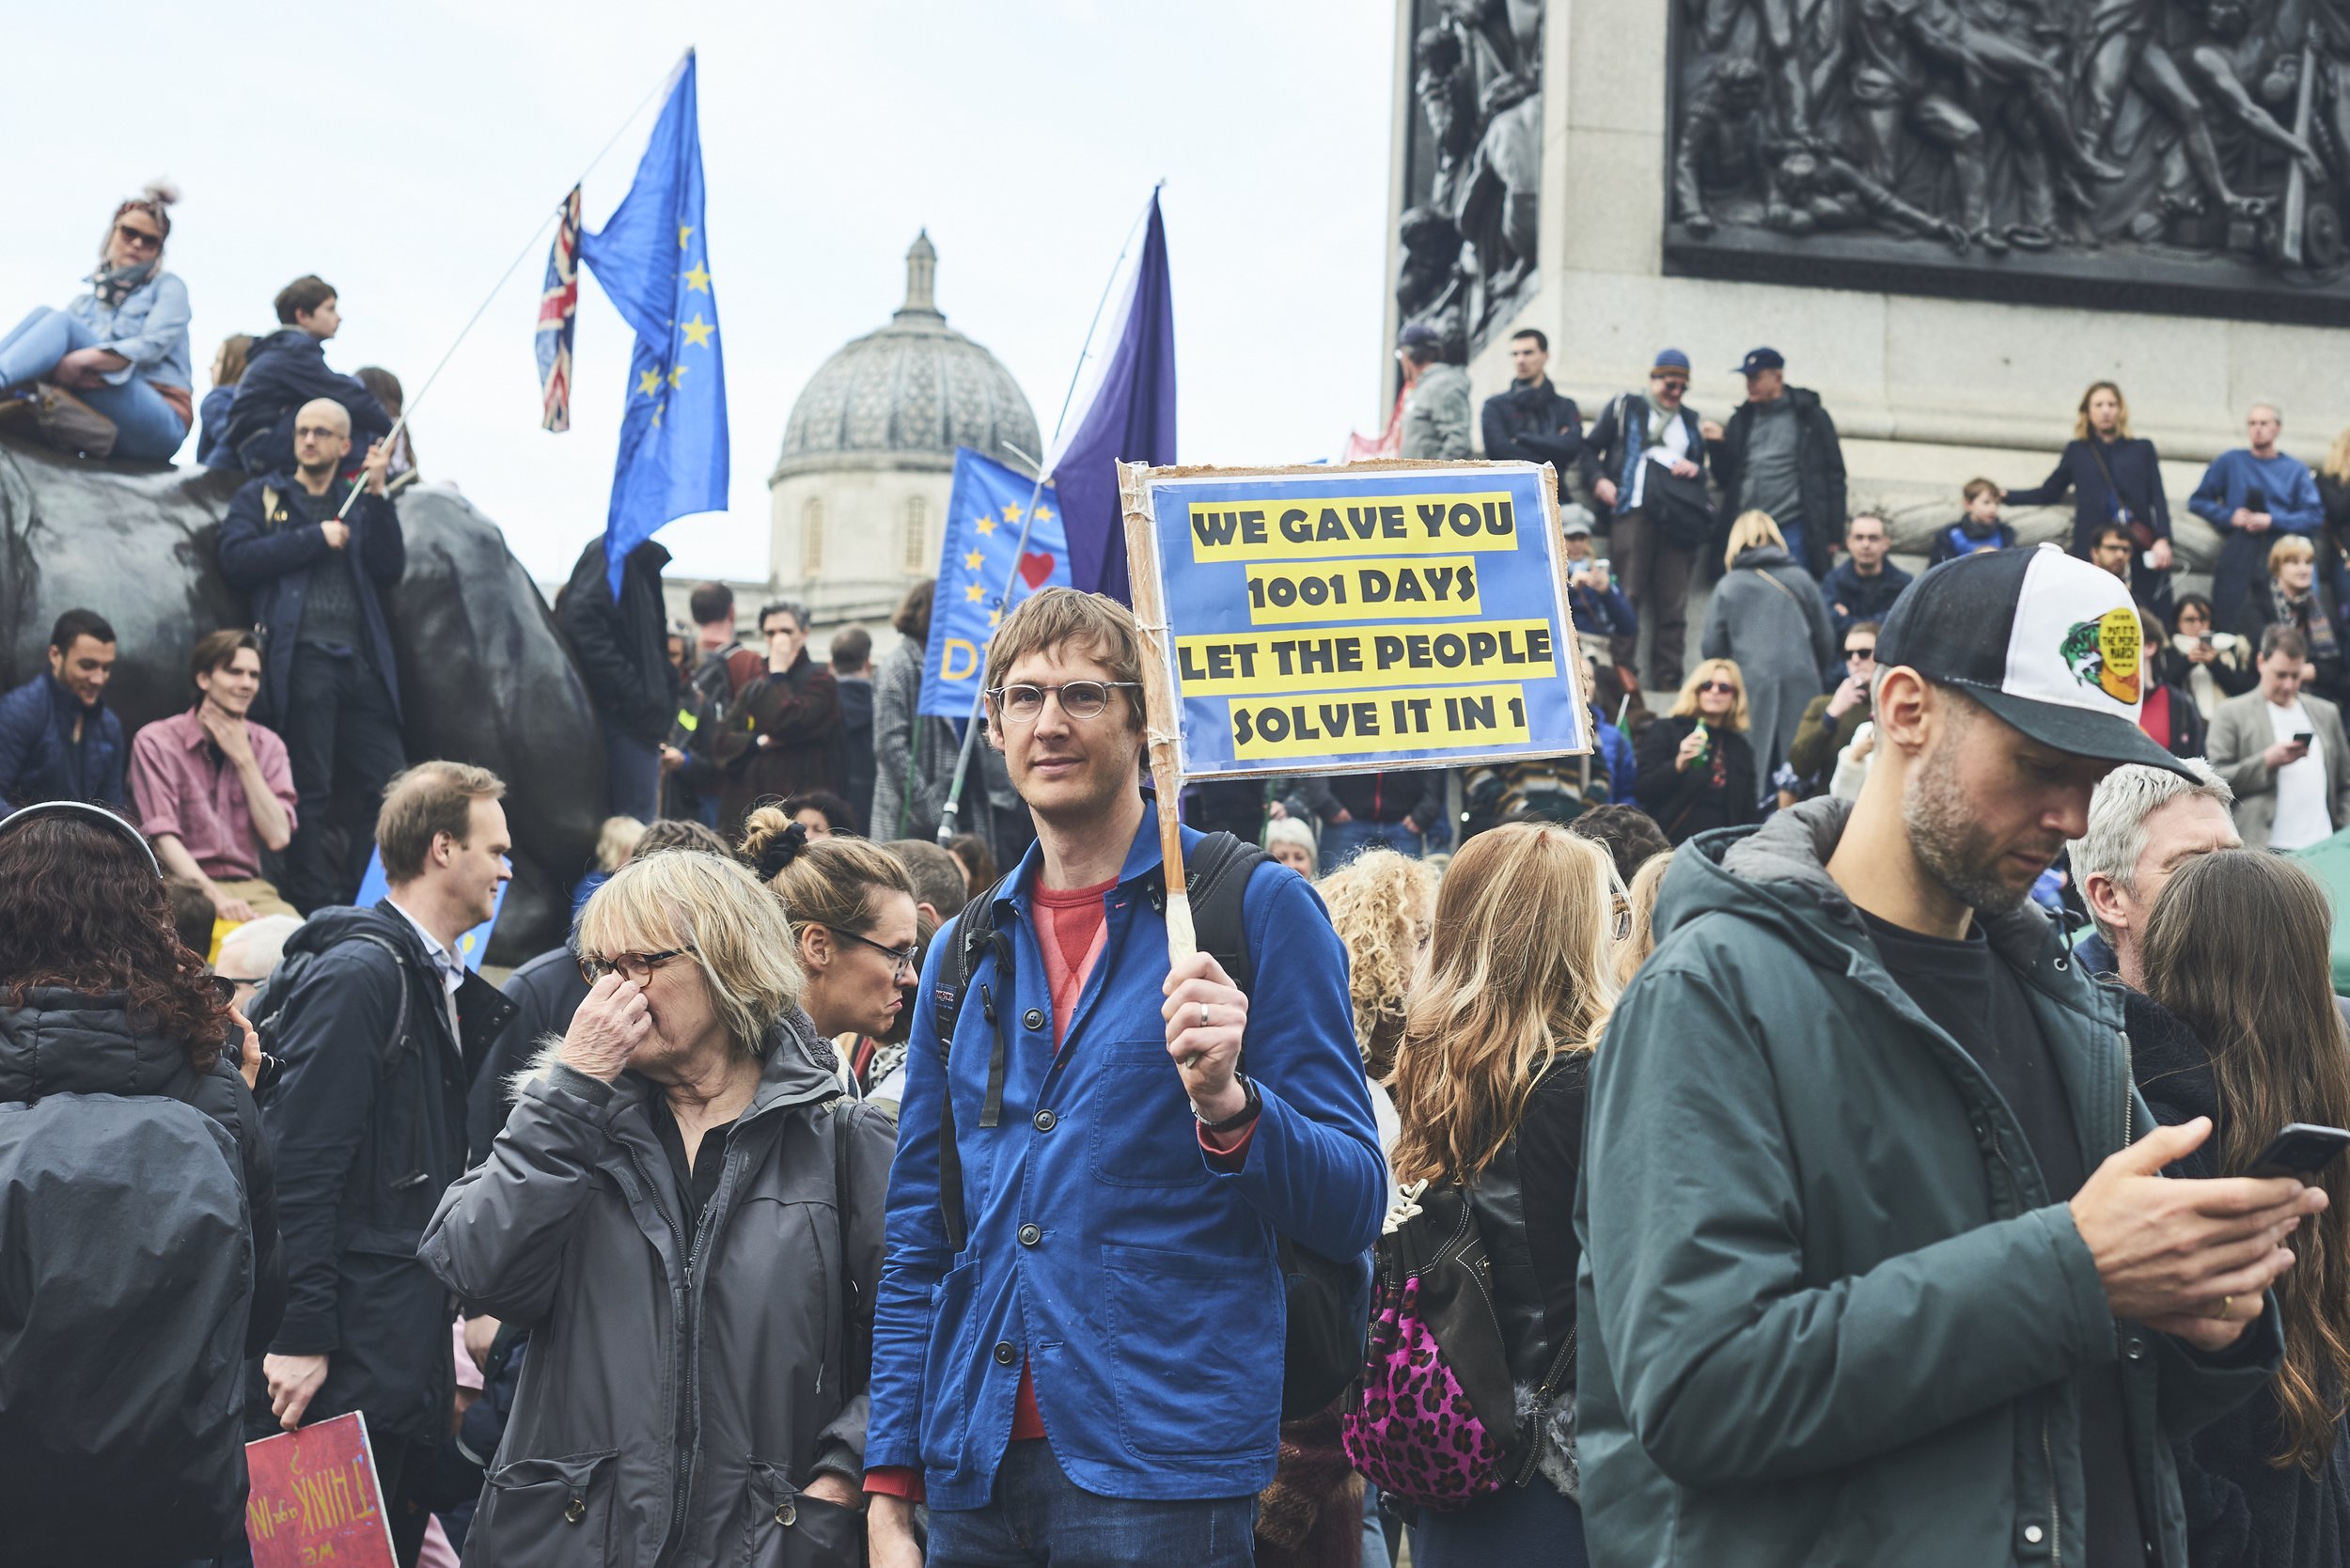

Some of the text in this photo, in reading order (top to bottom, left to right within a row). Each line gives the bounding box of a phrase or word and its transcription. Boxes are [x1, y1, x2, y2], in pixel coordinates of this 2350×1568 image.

[1192, 501, 1514, 547] WE GAVE YOU
[1247, 565, 1476, 608] 1001 DAYS
[940, 637, 990, 681] D
[1179, 629, 1553, 681] LET THE PEOPLE
[2102, 635, 2116, 647] THE
[2109, 647, 2136, 660] MARCH
[1233, 695, 1527, 745] SOLVE IT IN 1
[290, 1460, 376, 1538] THINK
